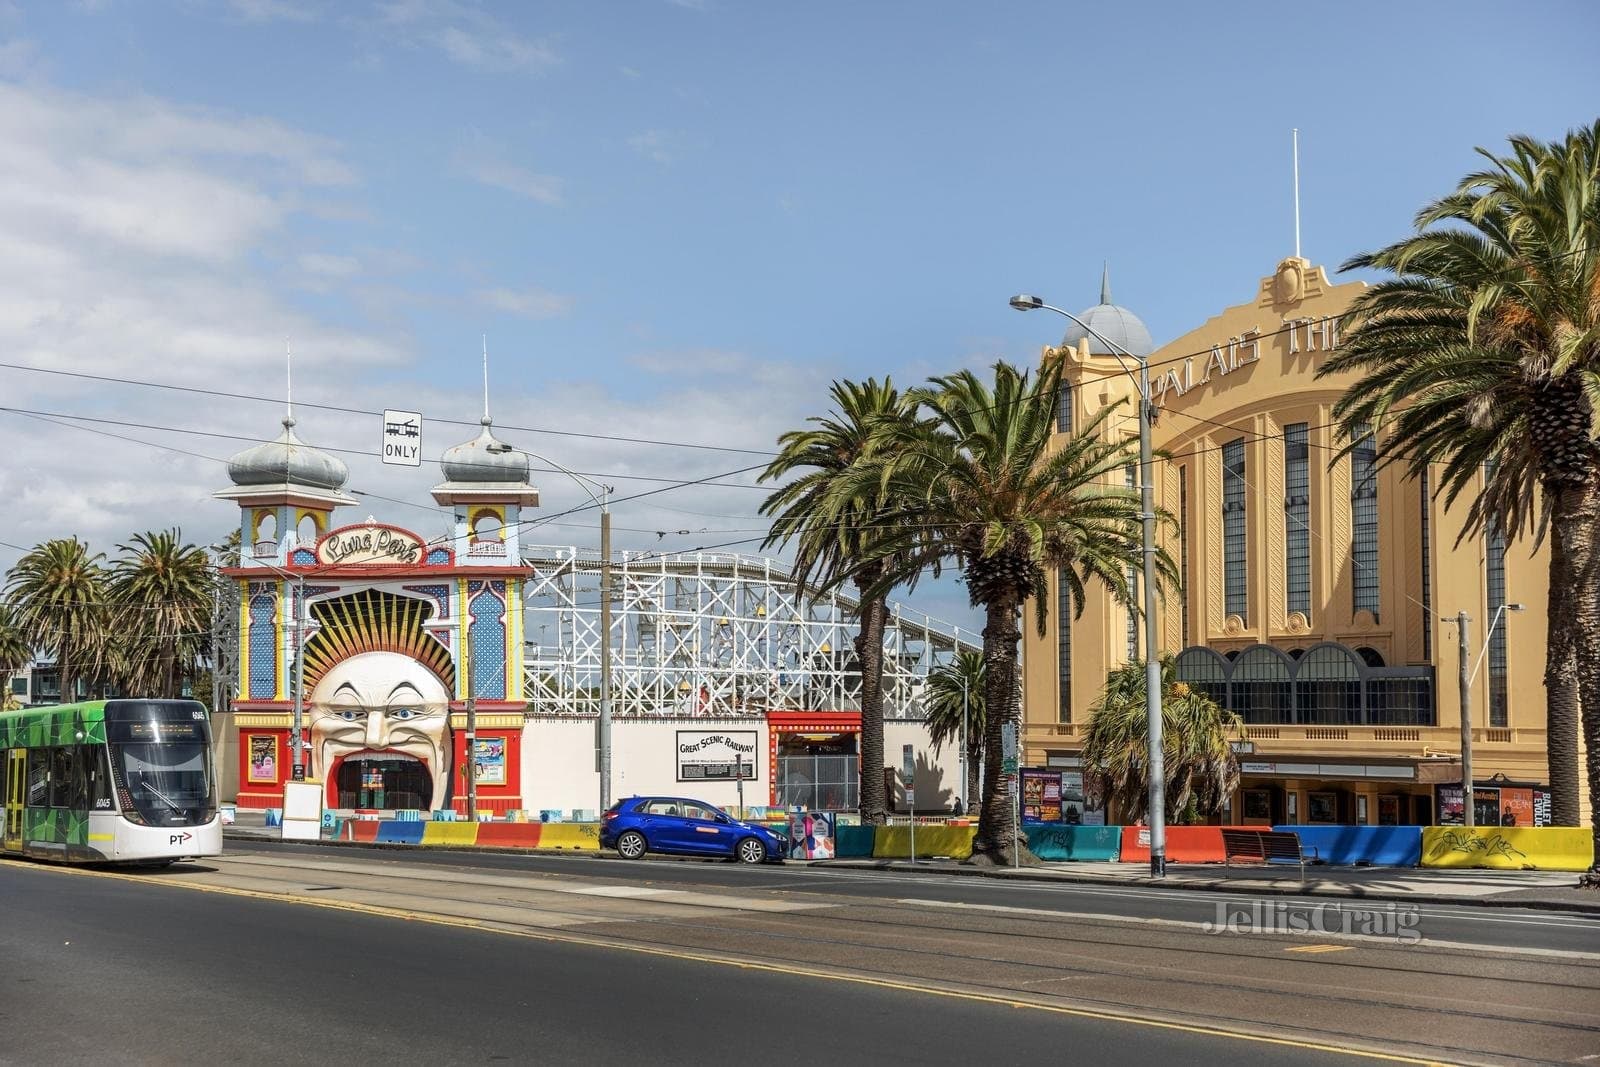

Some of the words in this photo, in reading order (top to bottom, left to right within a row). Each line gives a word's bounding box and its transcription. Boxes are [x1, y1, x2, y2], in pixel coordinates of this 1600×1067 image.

[386, 444, 417, 458] ONLY
[680, 744, 701, 753] GREAT
[700, 736, 724, 748] SCENIC
[724, 737, 754, 753] RAILWAY
[96, 798, 111, 808] 6045
